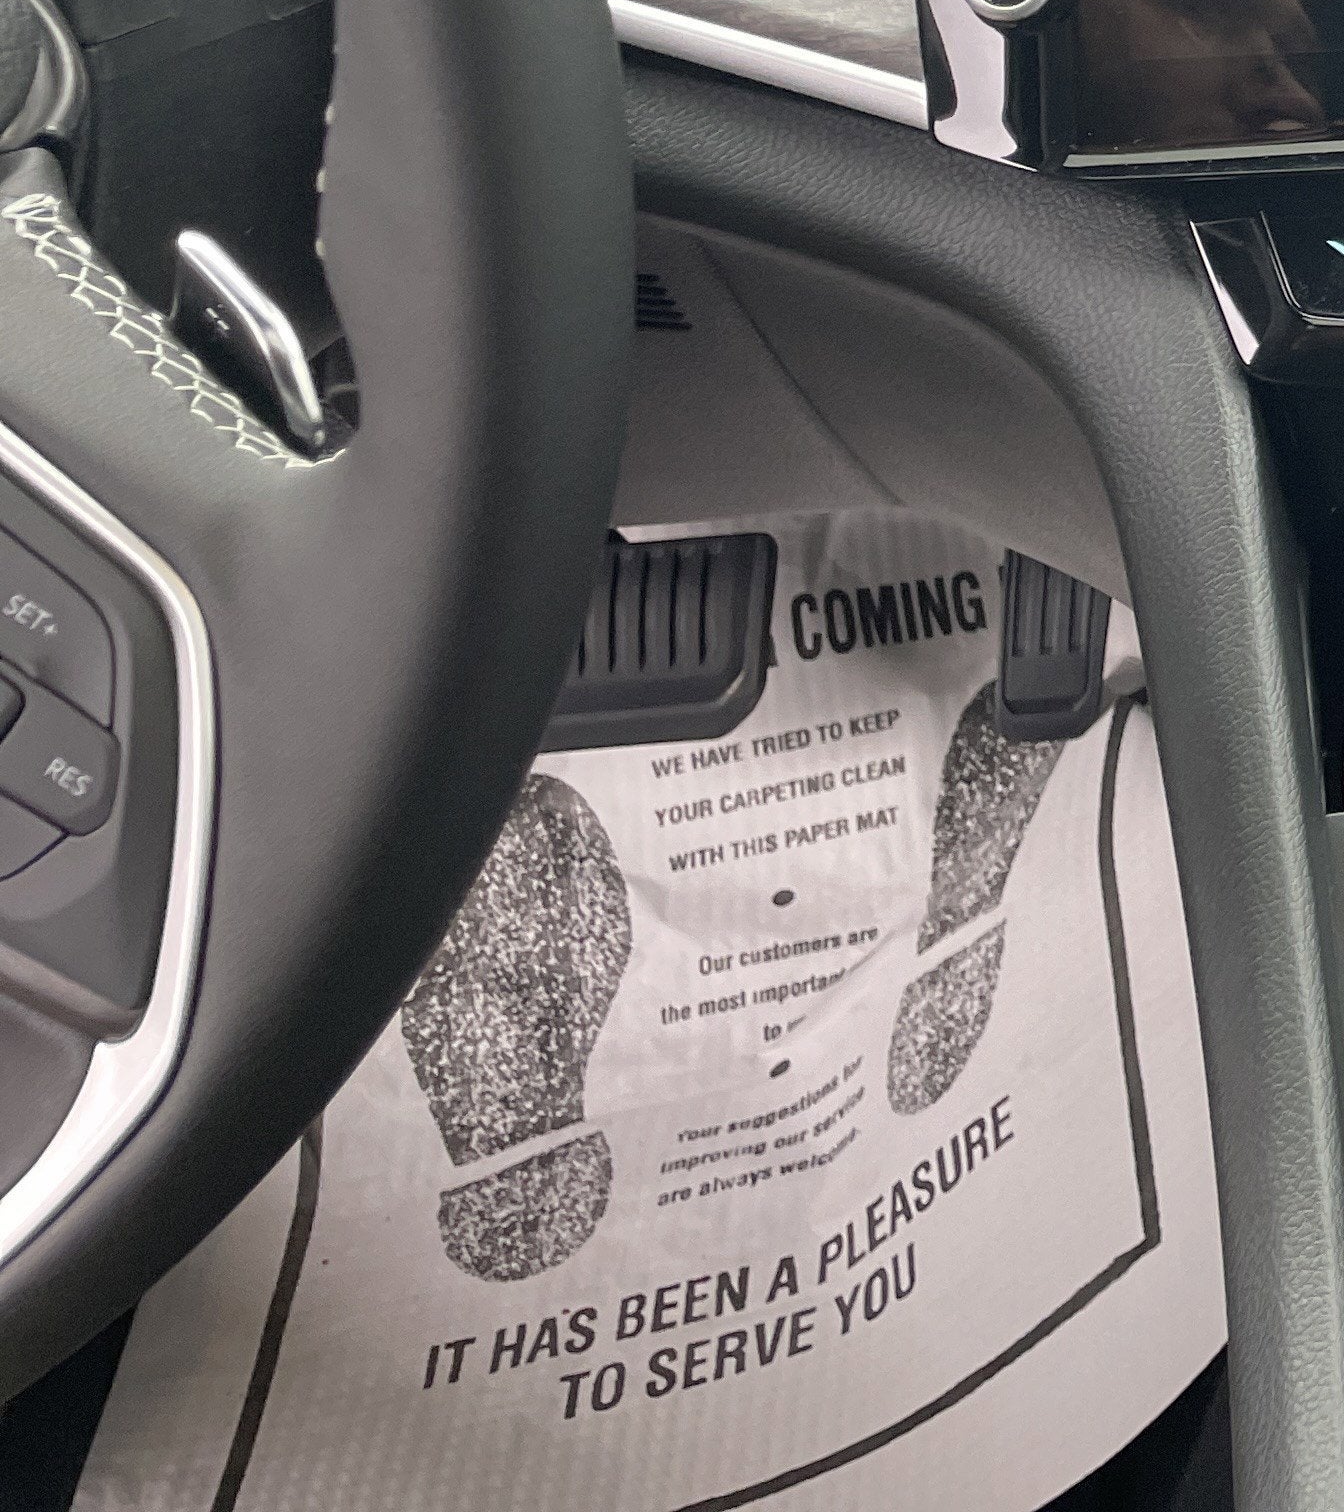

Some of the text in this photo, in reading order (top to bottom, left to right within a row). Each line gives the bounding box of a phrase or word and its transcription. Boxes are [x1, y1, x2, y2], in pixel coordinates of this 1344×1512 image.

[2, 593, 59, 639] SET+
[791, 570, 988, 661] COMING
[651, 708, 901, 779] WE HAVE TRIED TO KEEP
[44, 757, 94, 797] RES
[655, 755, 906, 828] YOUR CARPETING CLEAN
[669, 806, 900, 872] WITH THIS PAPER MAT
[699, 927, 878, 976] Our customers are
[660, 1004, 691, 1025] the
[698, 991, 747, 1017] most
[763, 1023, 782, 1042] to
[660, 1141, 767, 1174] improving
[773, 1129, 809, 1150] our
[657, 1187, 692, 1206] are
[699, 1166, 773, 1197] always
[424, 1094, 1015, 1390] IT HAS BEEN A PLEASURE
[560, 1241, 917, 1420] TO SERVE YOU
